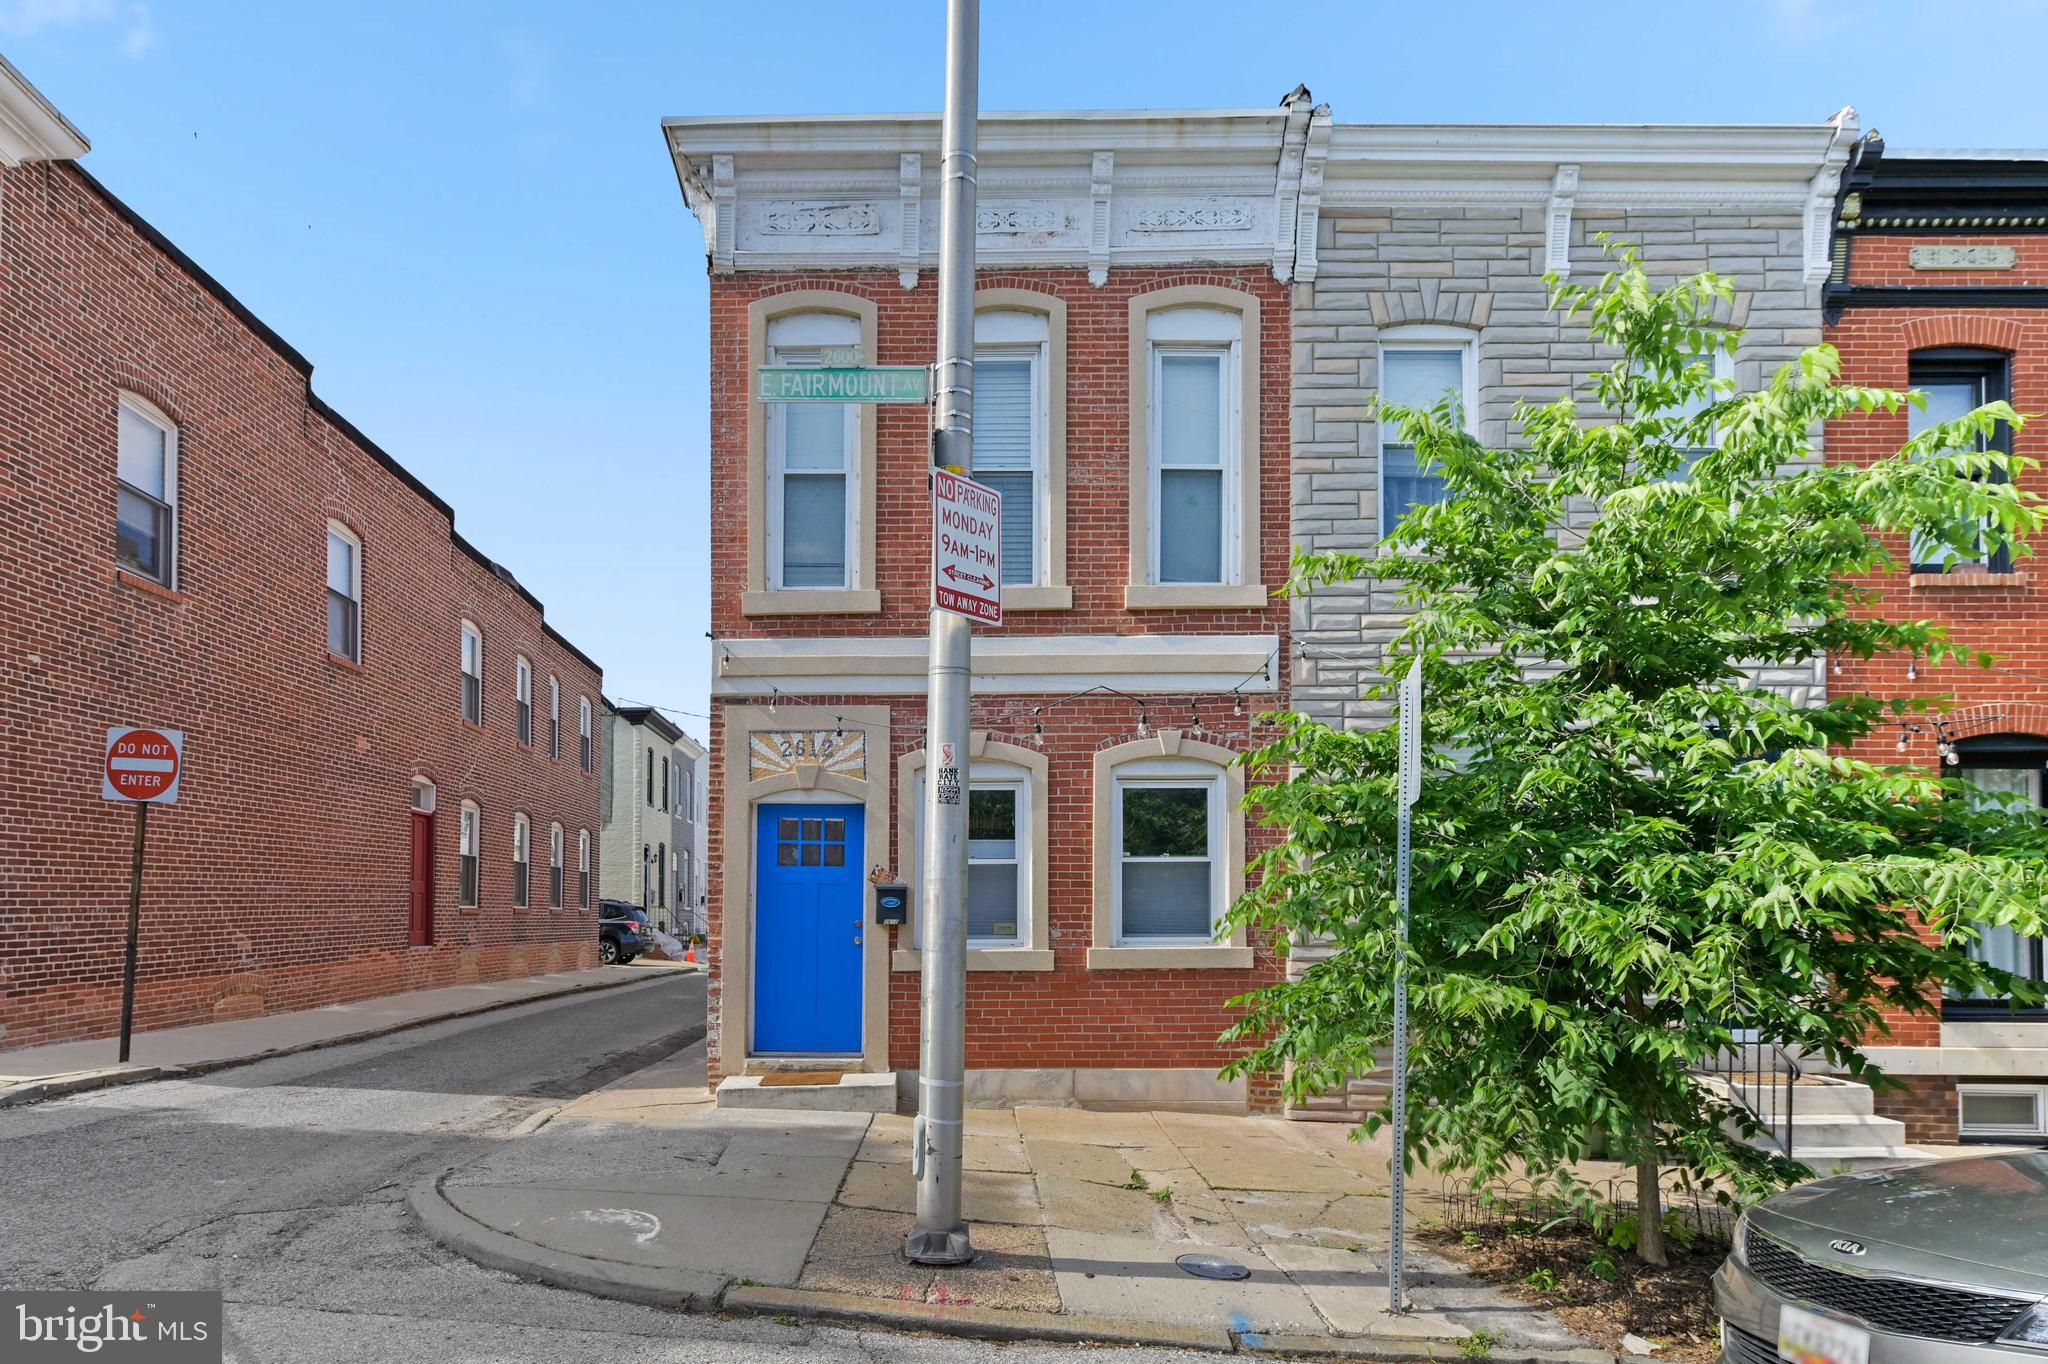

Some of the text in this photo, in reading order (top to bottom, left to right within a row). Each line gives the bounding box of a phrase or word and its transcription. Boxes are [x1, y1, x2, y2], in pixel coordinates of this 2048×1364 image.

[825, 350, 856, 364] 2600
[760, 373, 921, 396] E. FAIRMOUNT AV
[938, 476, 997, 516] NO PARKING
[942, 507, 994, 540] MONDAY
[942, 533, 995, 568] 9AM-1PM
[948, 569, 990, 586] STREET CLEANING
[938, 590, 998, 618] TOW AWAY ZONE
[118, 742, 169, 756] DO NOT
[780, 738, 834, 759] 2612
[120, 774, 161, 787] ENTER
[1832, 1240, 1859, 1253] KIA
